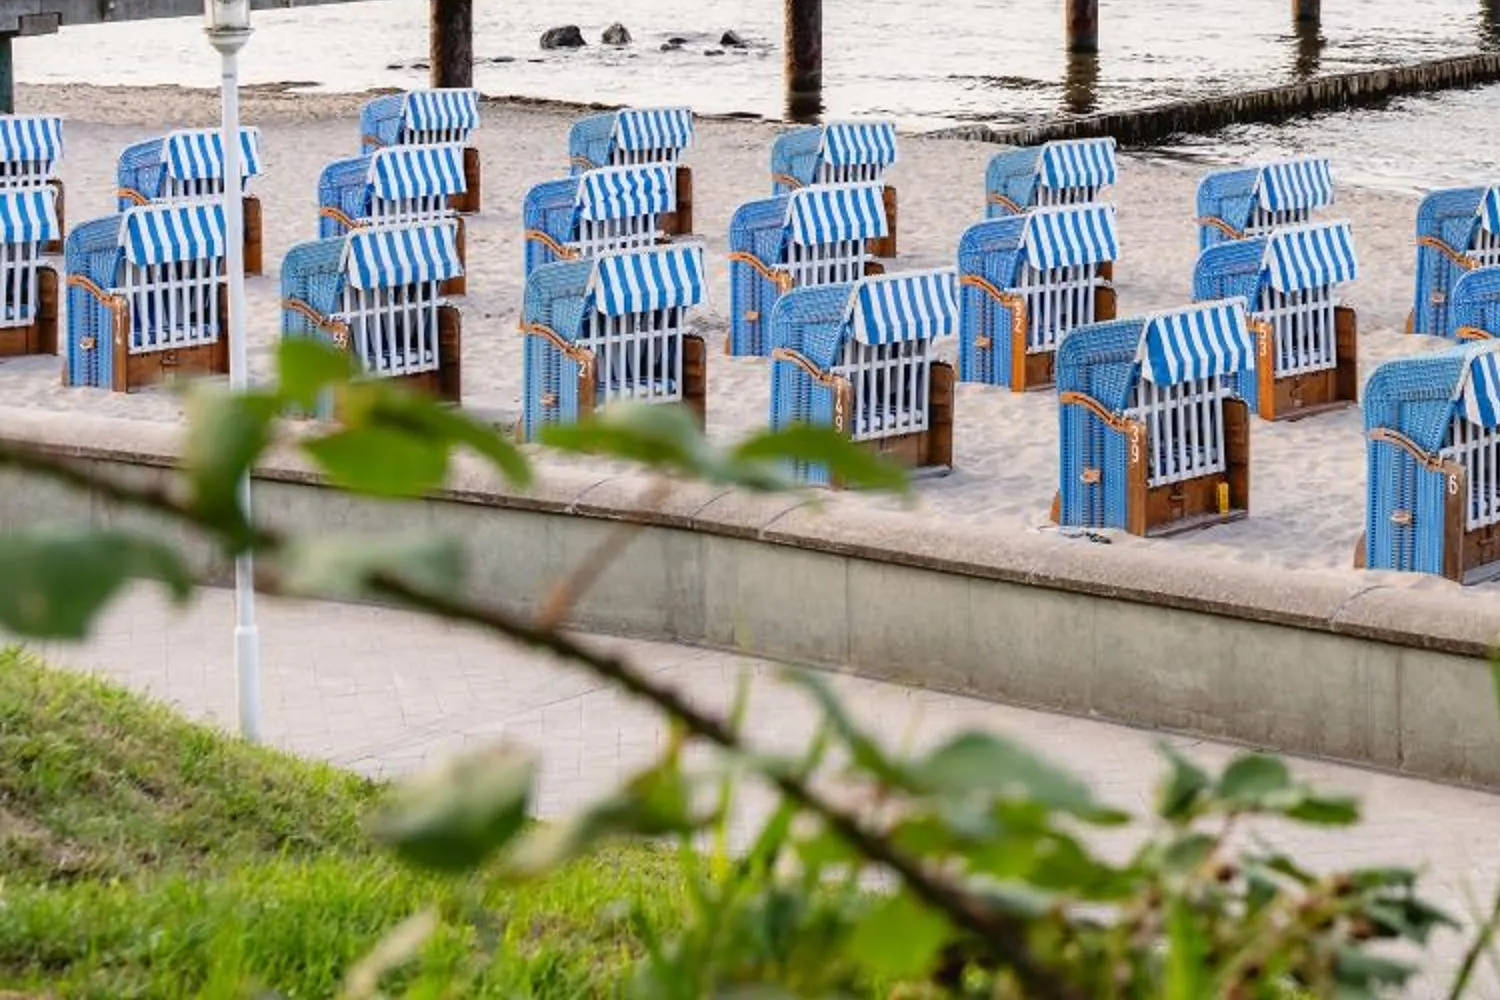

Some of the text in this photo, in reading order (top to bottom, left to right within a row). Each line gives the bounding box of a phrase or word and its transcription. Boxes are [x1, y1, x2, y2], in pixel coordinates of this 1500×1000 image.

[1259, 323, 1267, 357] 53
[1131, 425, 1139, 463] 39
[1449, 474, 1459, 495] 6
